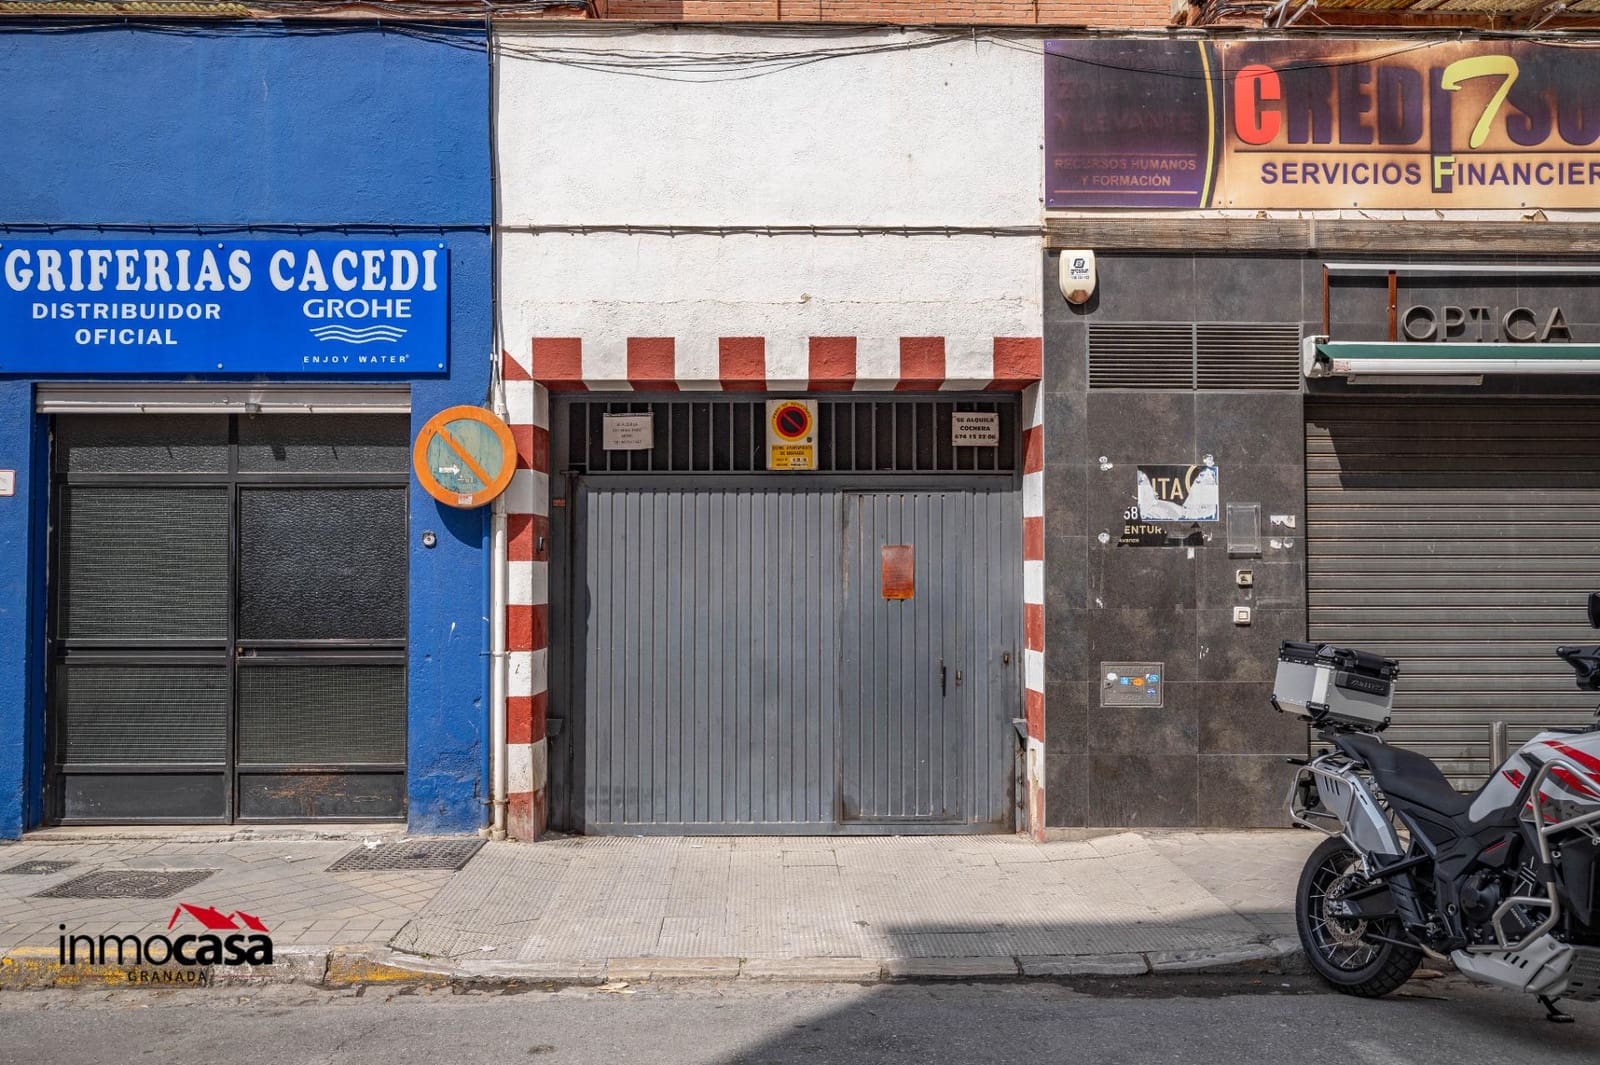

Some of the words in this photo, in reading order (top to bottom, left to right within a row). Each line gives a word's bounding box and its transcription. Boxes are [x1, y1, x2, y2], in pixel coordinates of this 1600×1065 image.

[1054, 159, 1127, 170] RECURSOS
[1131, 160, 1197, 170] HUMANOS
[1081, 175, 1089, 186] Y
[1093, 173, 1172, 187] FORMACIÓN
[1260, 162, 1422, 185] SERVICIOS
[4, 248, 252, 292] GRIFERIAS
[268, 248, 438, 292] CACEDI
[32, 303, 222, 320] DISTRIBUIDOR
[302, 298, 412, 319] GROHE
[1401, 304, 1574, 342] OPTICA
[74, 328, 178, 345] OFICIAL
[303, 355, 349, 363] ENJOY
